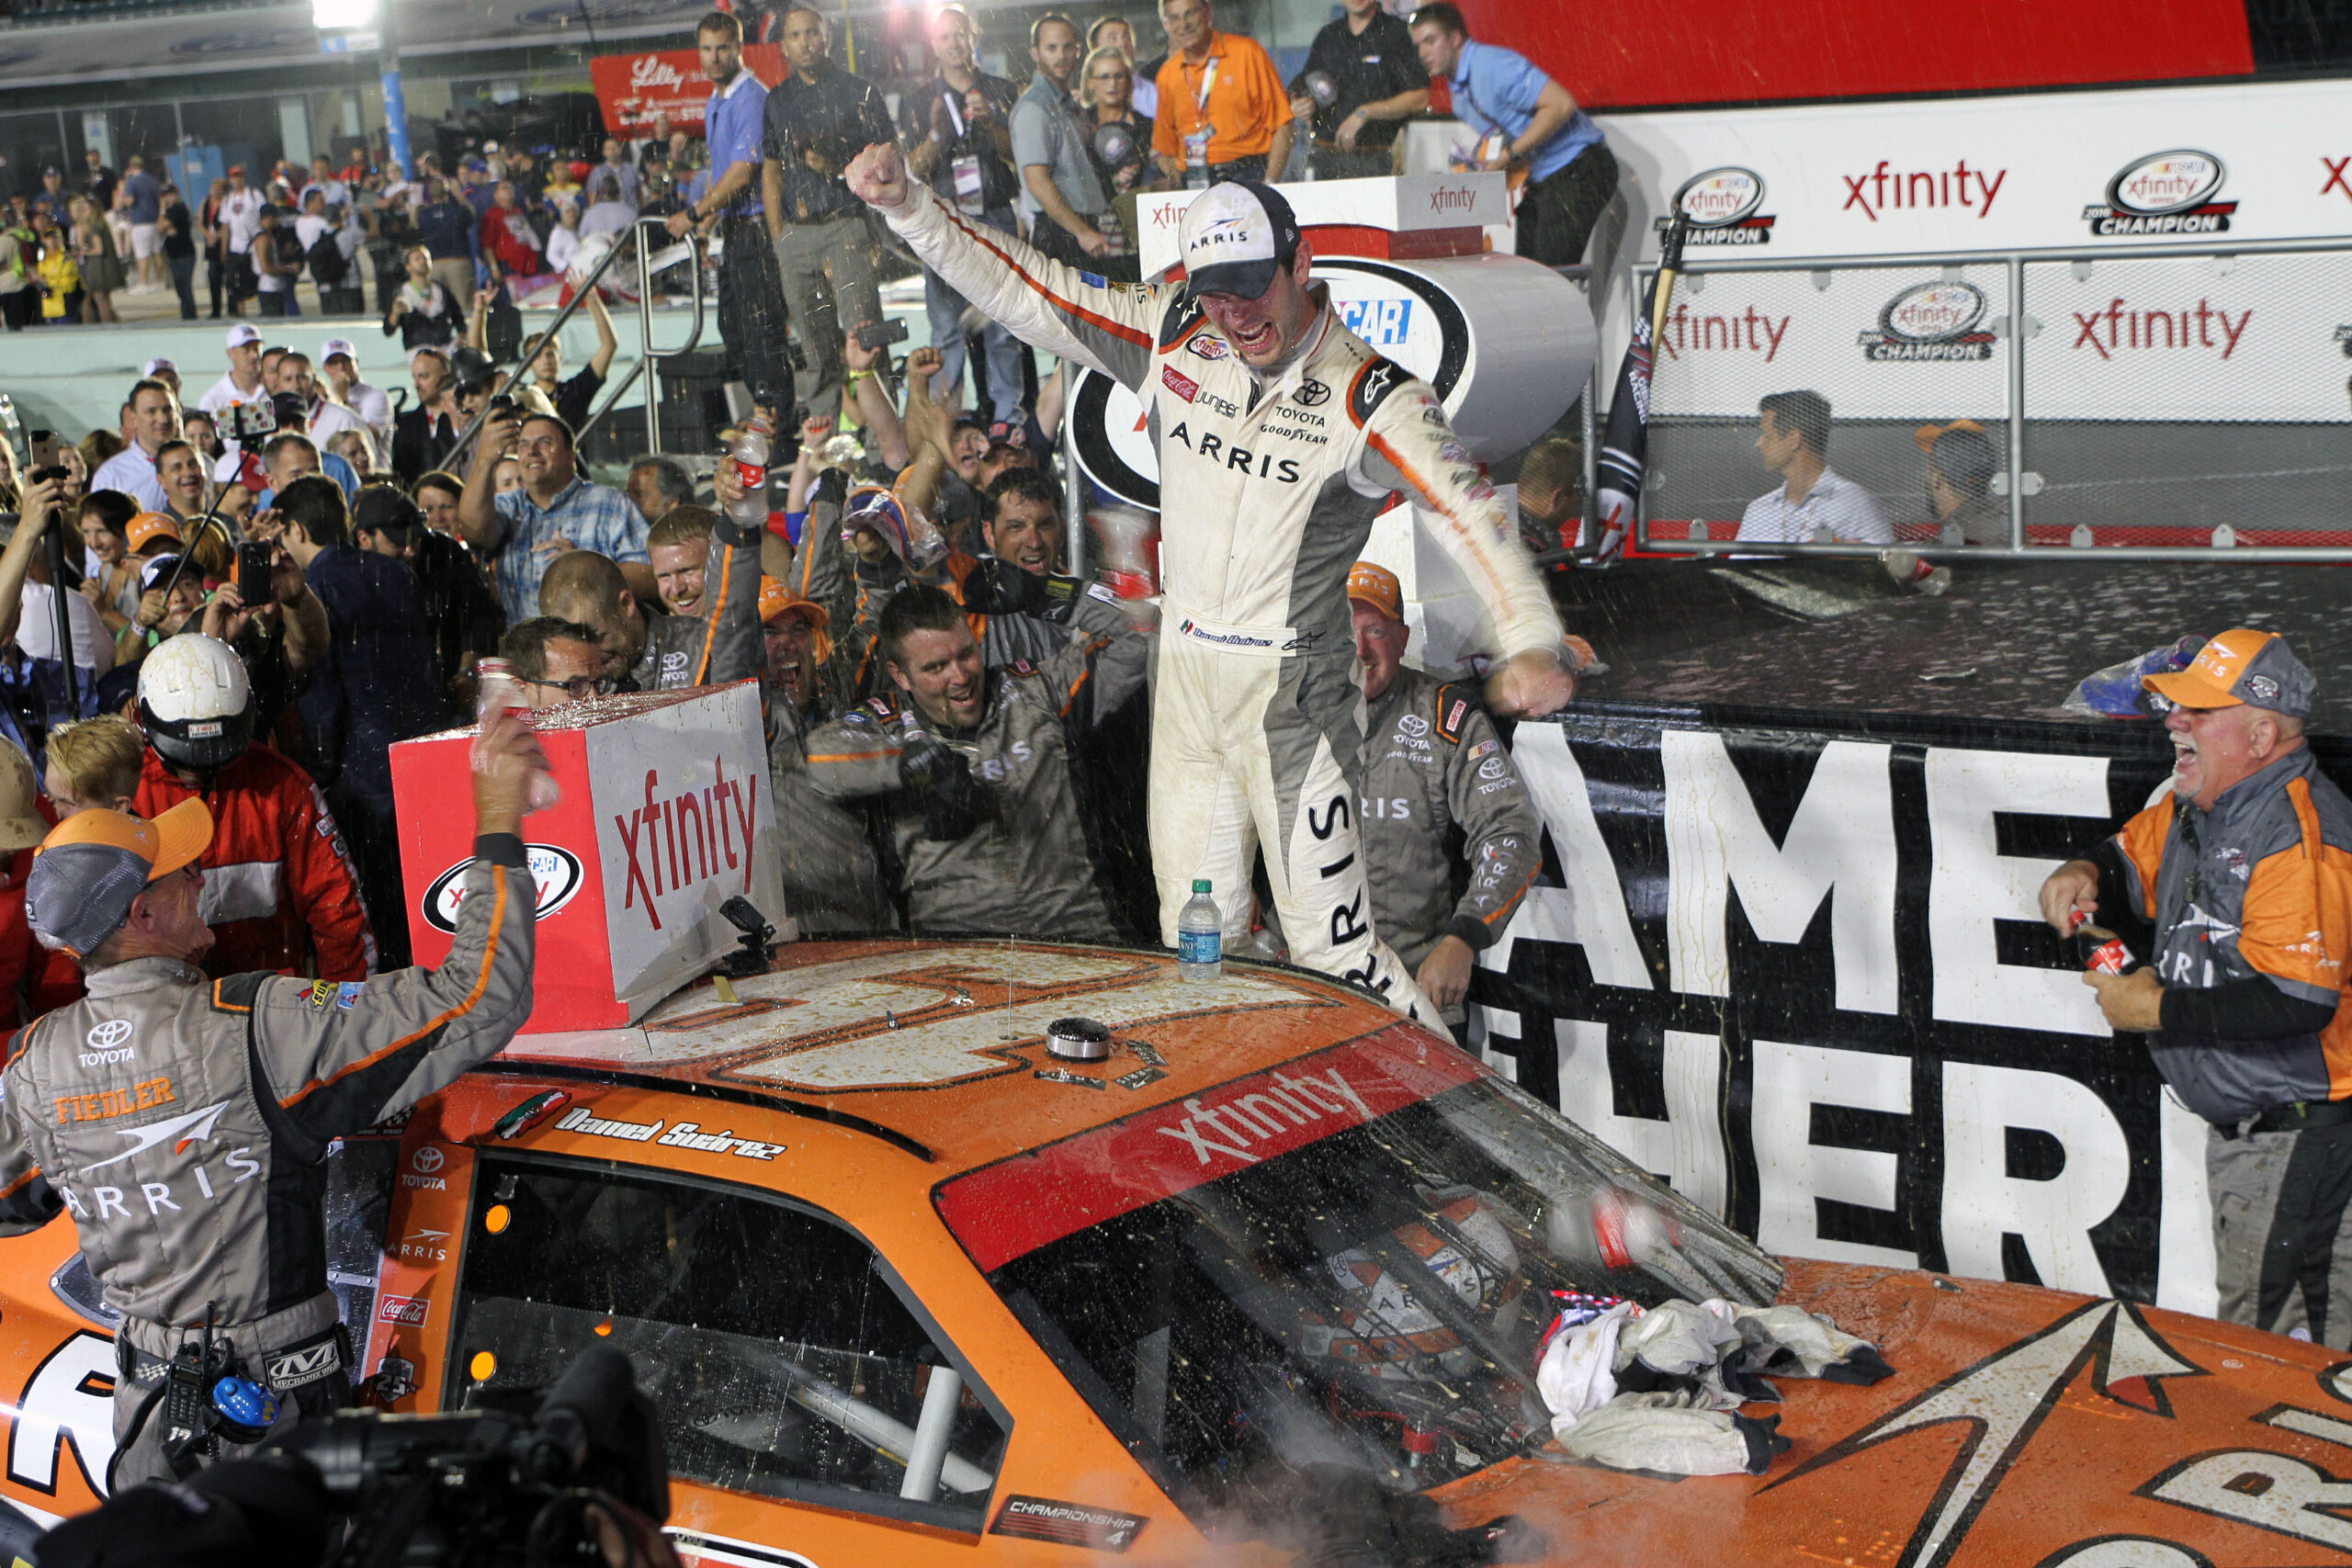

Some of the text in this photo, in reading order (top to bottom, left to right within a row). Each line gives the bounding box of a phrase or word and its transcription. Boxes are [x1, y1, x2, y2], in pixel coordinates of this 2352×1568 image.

[630, 54, 684, 93] Lilly
[1842, 159, 2007, 222] xfinity
[2127, 175, 2198, 199] xfinity
[1430, 186, 1476, 215] xfinity
[1686, 190, 1744, 211] xfinity
[2085, 208, 2110, 220] 2016
[2099, 214, 2220, 236] CHAMPION
[1191, 231, 1248, 254] ARRIS
[1685, 228, 1761, 244] HAMPION
[1897, 304, 1962, 329] xfinity
[2073, 298, 2253, 360] xfinity
[1193, 338, 1226, 357] xfinity
[1873, 343, 1980, 361] CHAMPION
[1275, 407, 1326, 427] TOYOTA
[1168, 422, 1301, 483] ARRIS
[615, 753, 757, 931] xfinity
[1474, 837, 1518, 908] ARRIS
[79, 1049, 135, 1068] TOYOTA
[54, 1076, 176, 1125] FIEDLER
[1155, 1066, 1374, 1166] xfinity
[554, 1107, 787, 1161] Daniel Suárez
[62, 1146, 261, 1220] ARRIS
[401, 1174, 447, 1191] TOYOTA
[387, 1243, 447, 1261] ARRIS
[272, 1359, 341, 1391] MECHANIX WEAR
[1010, 1500, 1136, 1529] CHAMPIONSHIP
[1105, 1530, 1125, 1545] 4
